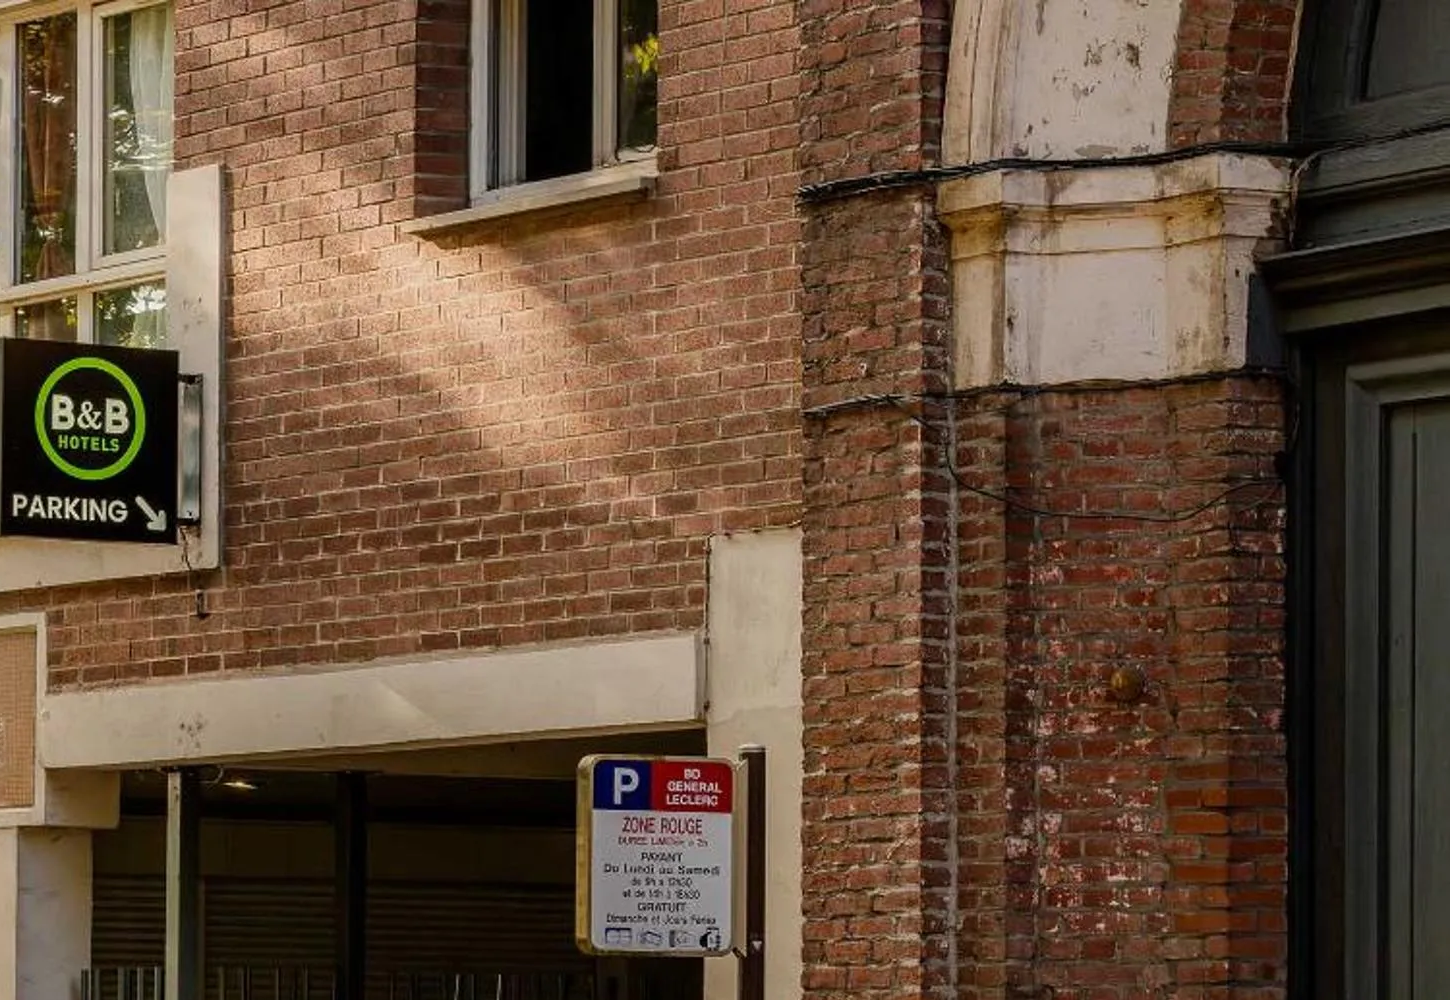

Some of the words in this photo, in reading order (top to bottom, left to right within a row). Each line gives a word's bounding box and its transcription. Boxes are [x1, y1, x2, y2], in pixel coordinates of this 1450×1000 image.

[51, 393, 130, 434] B&B
[58, 434, 120, 452] HOTELS
[12, 494, 129, 523] PARKING
[683, 768, 701, 780] BD
[613, 767, 640, 805] P
[667, 781, 723, 793] GENERAL
[666, 794, 718, 806] LECLERC
[622, 817, 656, 833] ZONE
[660, 817, 703, 834] ROUGE
[640, 852, 683, 862] PAYANT
[604, 863, 619, 873] Du
[624, 863, 654, 874] Lundi
[659, 867, 673, 875] au
[678, 865, 720, 876] Samedi
[634, 889, 645, 898] de
[637, 902, 686, 912] GRATUIT
